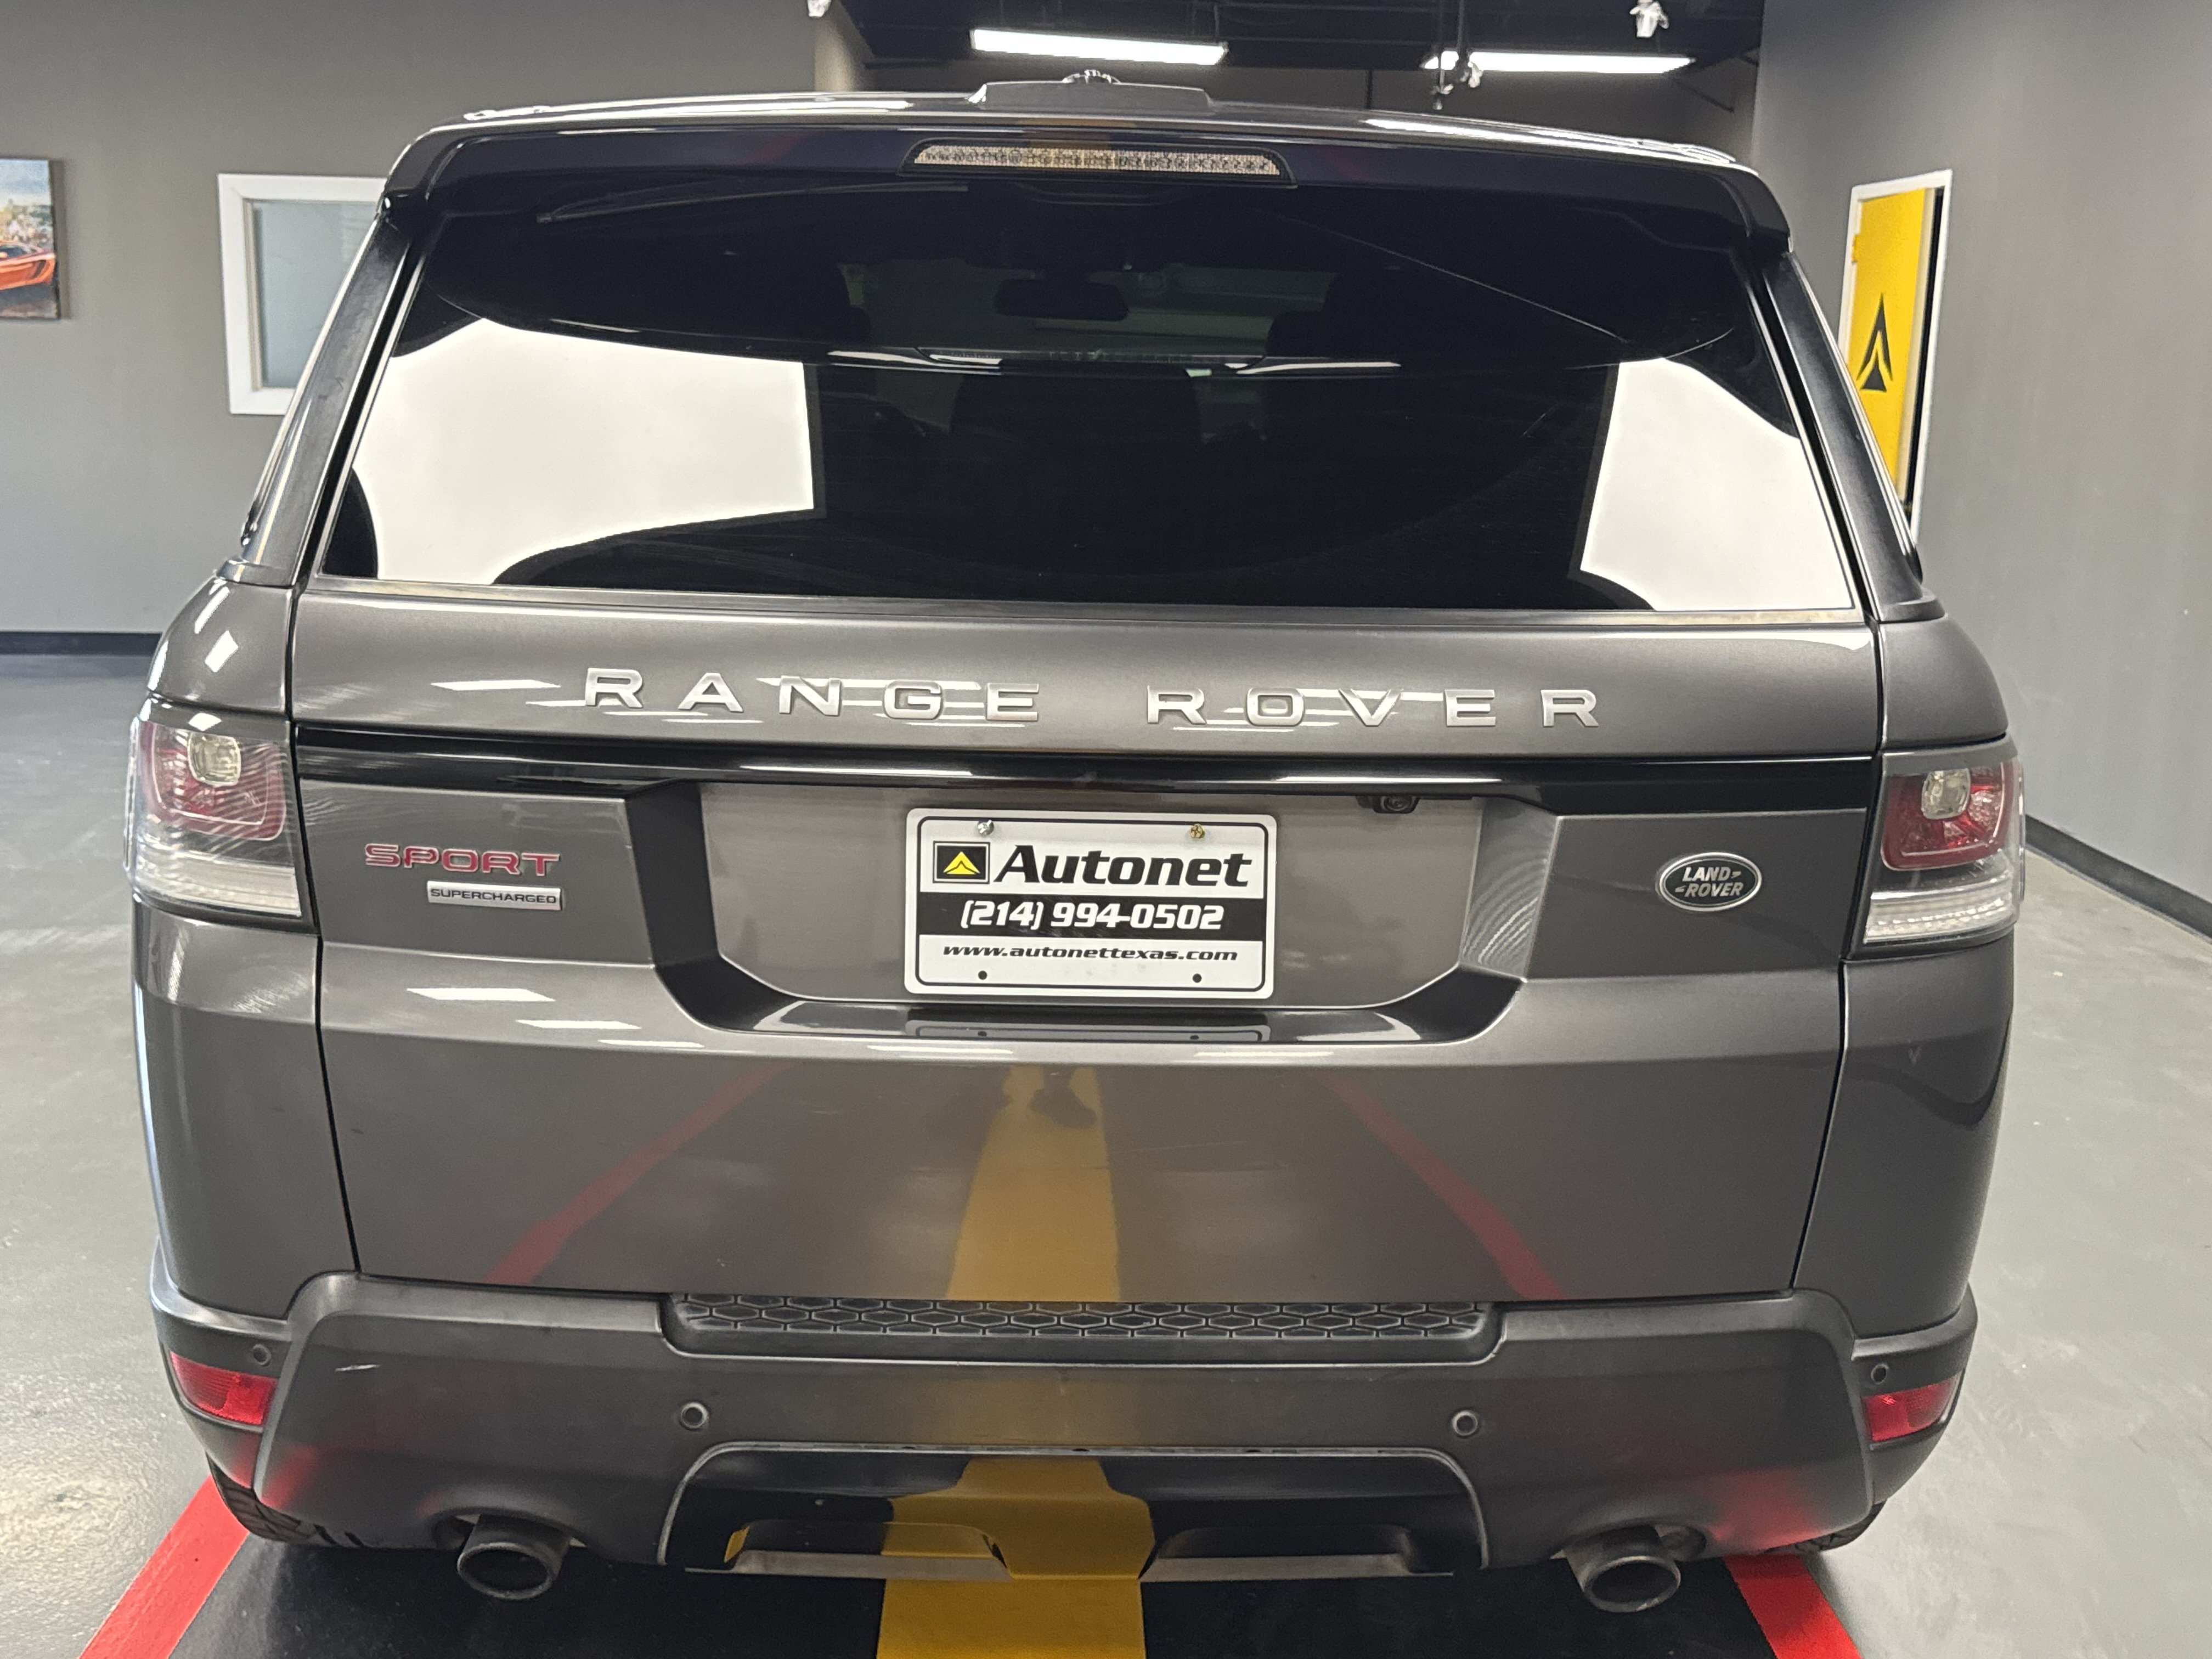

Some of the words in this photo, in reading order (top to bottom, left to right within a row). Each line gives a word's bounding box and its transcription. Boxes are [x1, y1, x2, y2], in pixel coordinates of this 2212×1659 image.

[585, 667, 1039, 721] RANGE
[1147, 685, 1599, 727] ROVER
[365, 843, 560, 876] SPORT
[994, 845, 1251, 887] Autonet
[1682, 867, 1731, 882] LAND
[431, 889, 556, 904] SUPERCHARGED
[1684, 882, 1743, 897] ROVER
[961, 900, 1044, 930] (214)
[1052, 902, 1224, 929] 994-0502
[943, 946, 1238, 961] www.autonettexas.com
